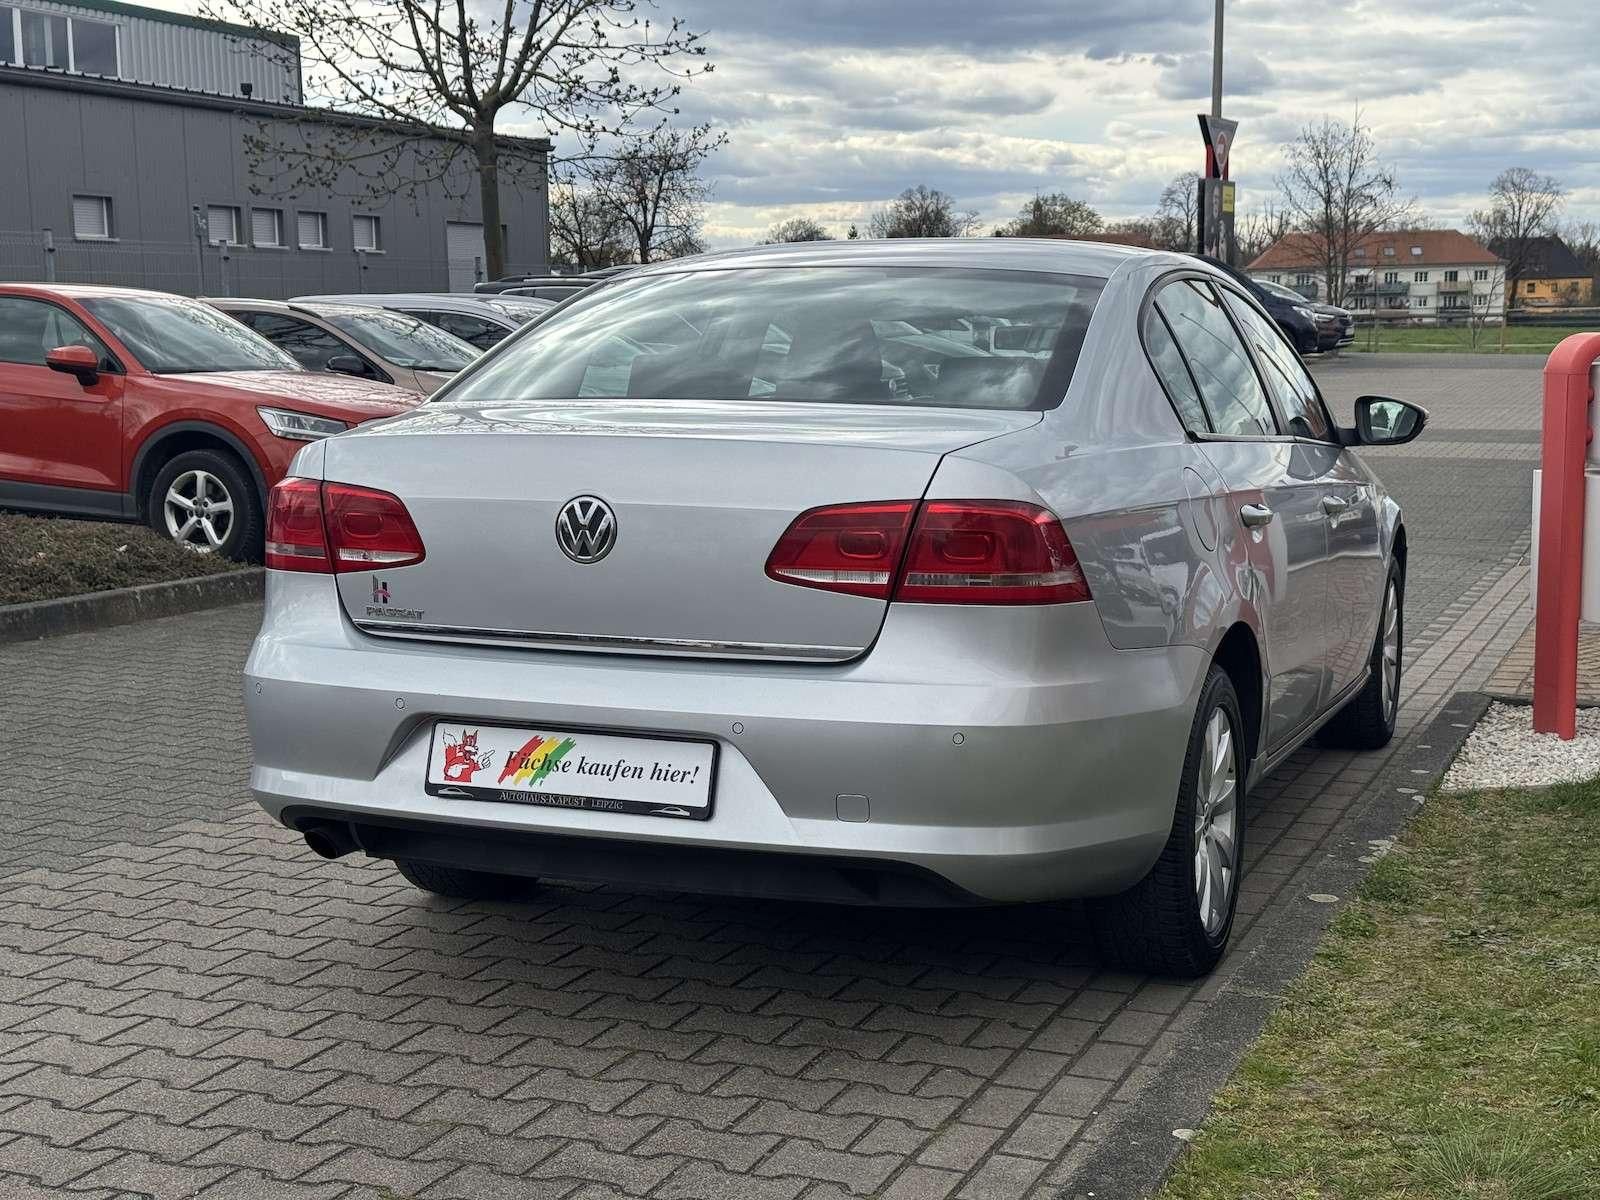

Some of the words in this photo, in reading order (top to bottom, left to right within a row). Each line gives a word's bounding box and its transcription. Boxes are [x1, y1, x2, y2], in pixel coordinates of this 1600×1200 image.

[556, 495, 617, 564] VW
[366, 606, 424, 620] PASSAT
[504, 751, 571, 774] Füchse
[577, 755, 643, 781] kaufen
[650, 761, 700, 784] hier!
[591, 799, 624, 810] LEIPZIG
